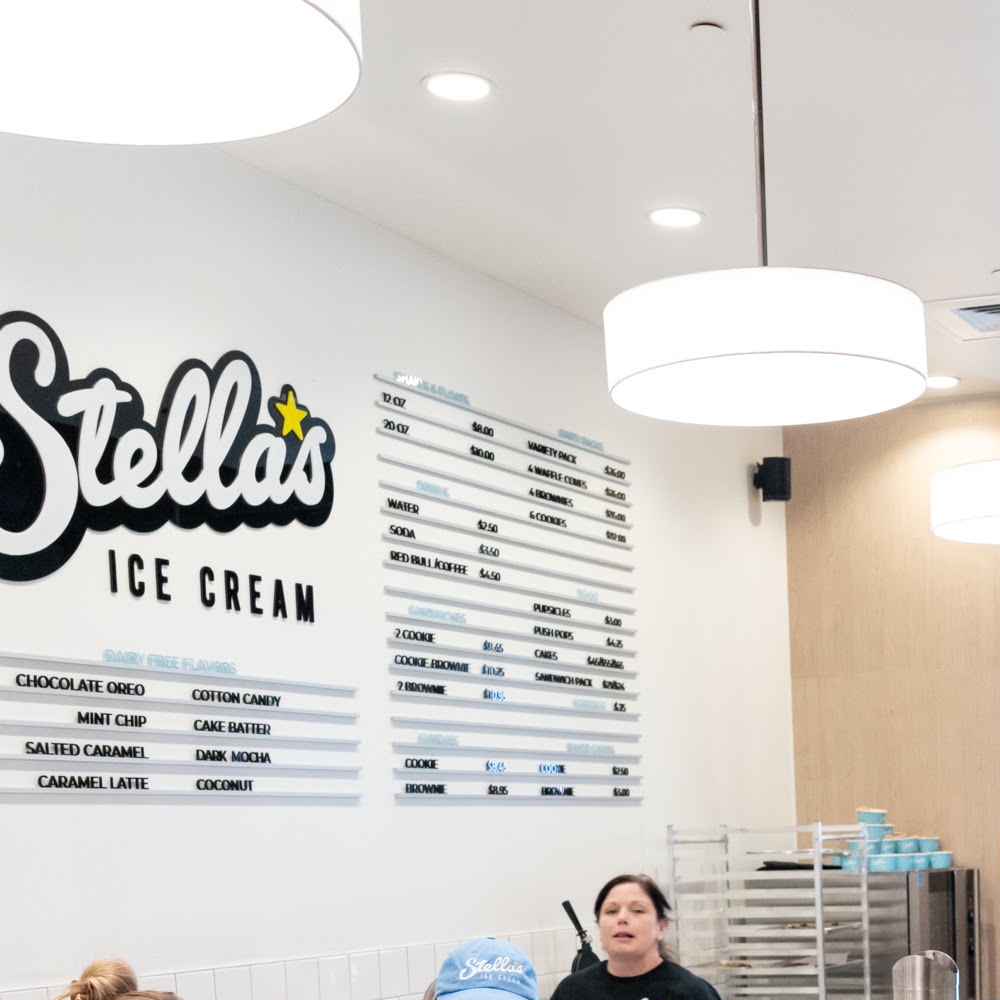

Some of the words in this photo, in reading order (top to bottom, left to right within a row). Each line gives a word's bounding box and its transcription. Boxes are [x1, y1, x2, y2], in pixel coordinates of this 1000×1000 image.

[382, 392, 393, 404] 12
[393, 396, 407, 409] OZ
[383, 418, 395, 431] 20
[397, 423, 410, 436] OZ
[528, 440, 558, 459] VARIETY
[558, 450, 577, 465] PACK
[528, 464, 534, 474] 4
[534, 466, 563, 484] WAFFLE
[564, 475, 588, 490] CONES
[387, 498, 419, 515] WATER
[529, 488, 535, 497] 4
[535, 489, 574, 508] BROWNIES
[536, 512, 567, 528] COOKIES
[390, 525, 416, 540] SODA
[390, 551, 409, 564] RED
[411, 554, 433, 568] BULL
[108, 549, 171, 603] ICE
[200, 566, 315, 624] CREAM
[395, 628, 401, 639] 2
[402, 630, 436, 644] COOKIE
[103, 649, 144, 667] DAIRY
[148, 654, 180, 671] FREE
[182, 658, 237, 675] FLAVORS
[394, 655, 429, 669] COOKIE
[431, 659, 471, 673] BROWNIE
[534, 650, 558, 661] CAKES
[15, 674, 103, 694] CHOCOLATE
[106, 681, 145, 697] OREO
[536, 672, 574, 686] SANDWICH
[575, 676, 593, 687] PACK
[397, 682, 403, 692] 2
[404, 682, 447, 696] BROWNIE
[192, 688, 240, 705] COTTON
[243, 693, 281, 708] CANDY
[77, 712, 112, 727] MINT
[115, 714, 147, 728] CHIP
[193, 720, 225, 734] CAKE
[228, 721, 271, 736] BATTER
[25, 742, 80, 757] SALTED
[83, 744, 149, 759] CARAMEL
[196, 749, 227, 762] DARK
[232, 751, 271, 764] MOCHA
[405, 758, 438, 770] COOKIE
[38, 775, 107, 789] CARAMEL
[110, 776, 149, 790] LATTE
[196, 779, 254, 792] COCONUT
[406, 783, 447, 795] BROWNIE
[459, 956, 523, 980] Stella's
